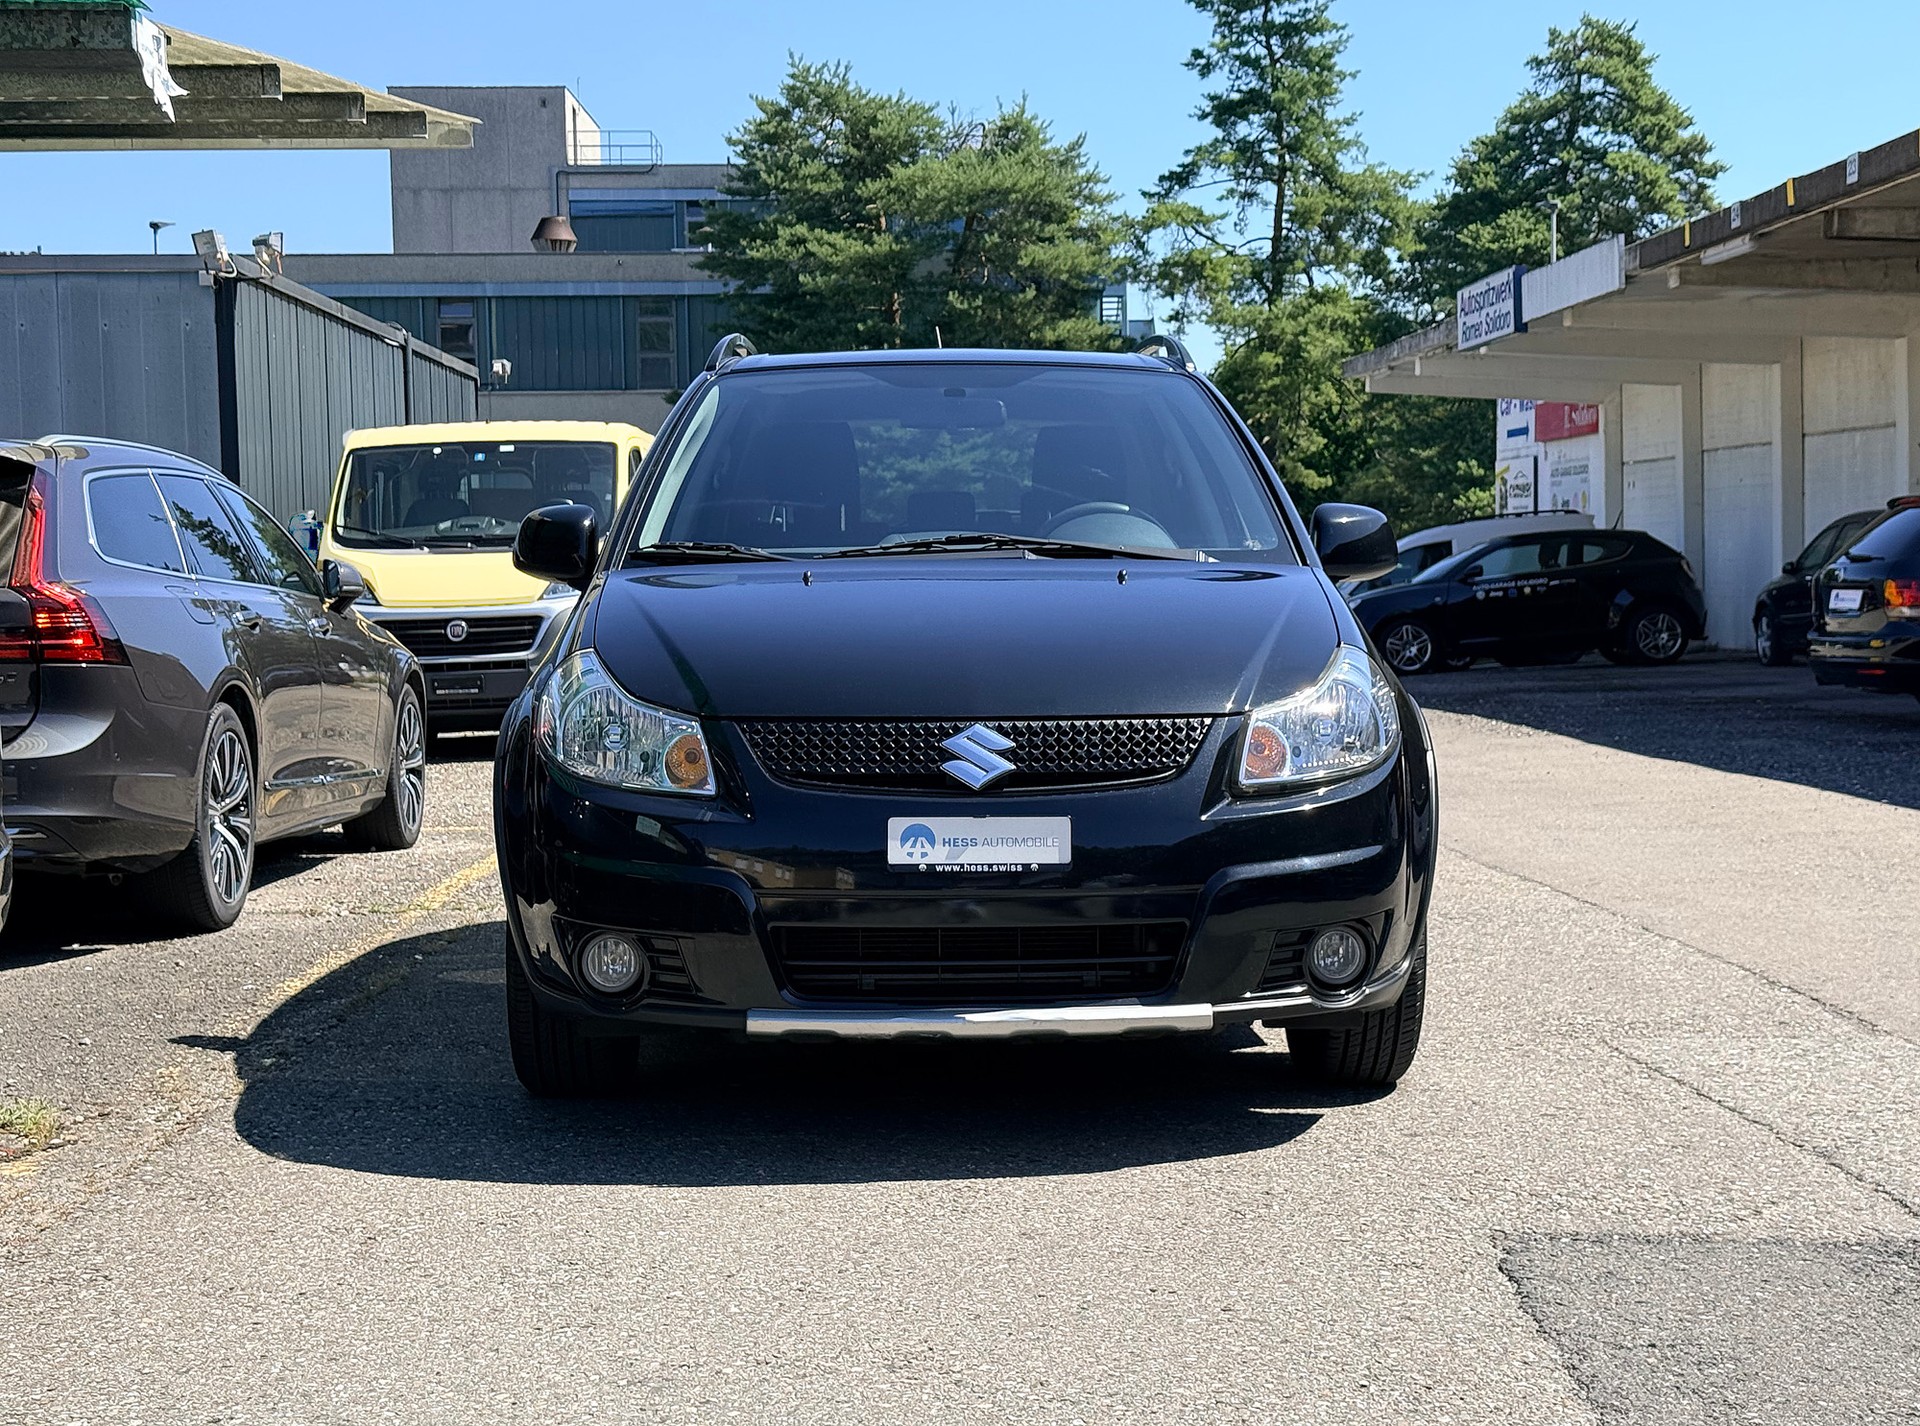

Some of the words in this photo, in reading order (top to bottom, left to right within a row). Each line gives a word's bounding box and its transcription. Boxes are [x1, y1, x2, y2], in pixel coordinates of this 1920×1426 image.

[1459, 272, 1513, 318] Autospritzwerk
[1461, 320, 1484, 344] Romeo
[1484, 306, 1512, 337] Solidoro
[942, 837, 978, 848] HESS
[981, 836, 1059, 848] AUTOMOBILE
[935, 863, 1023, 872] www.hess.swiss
